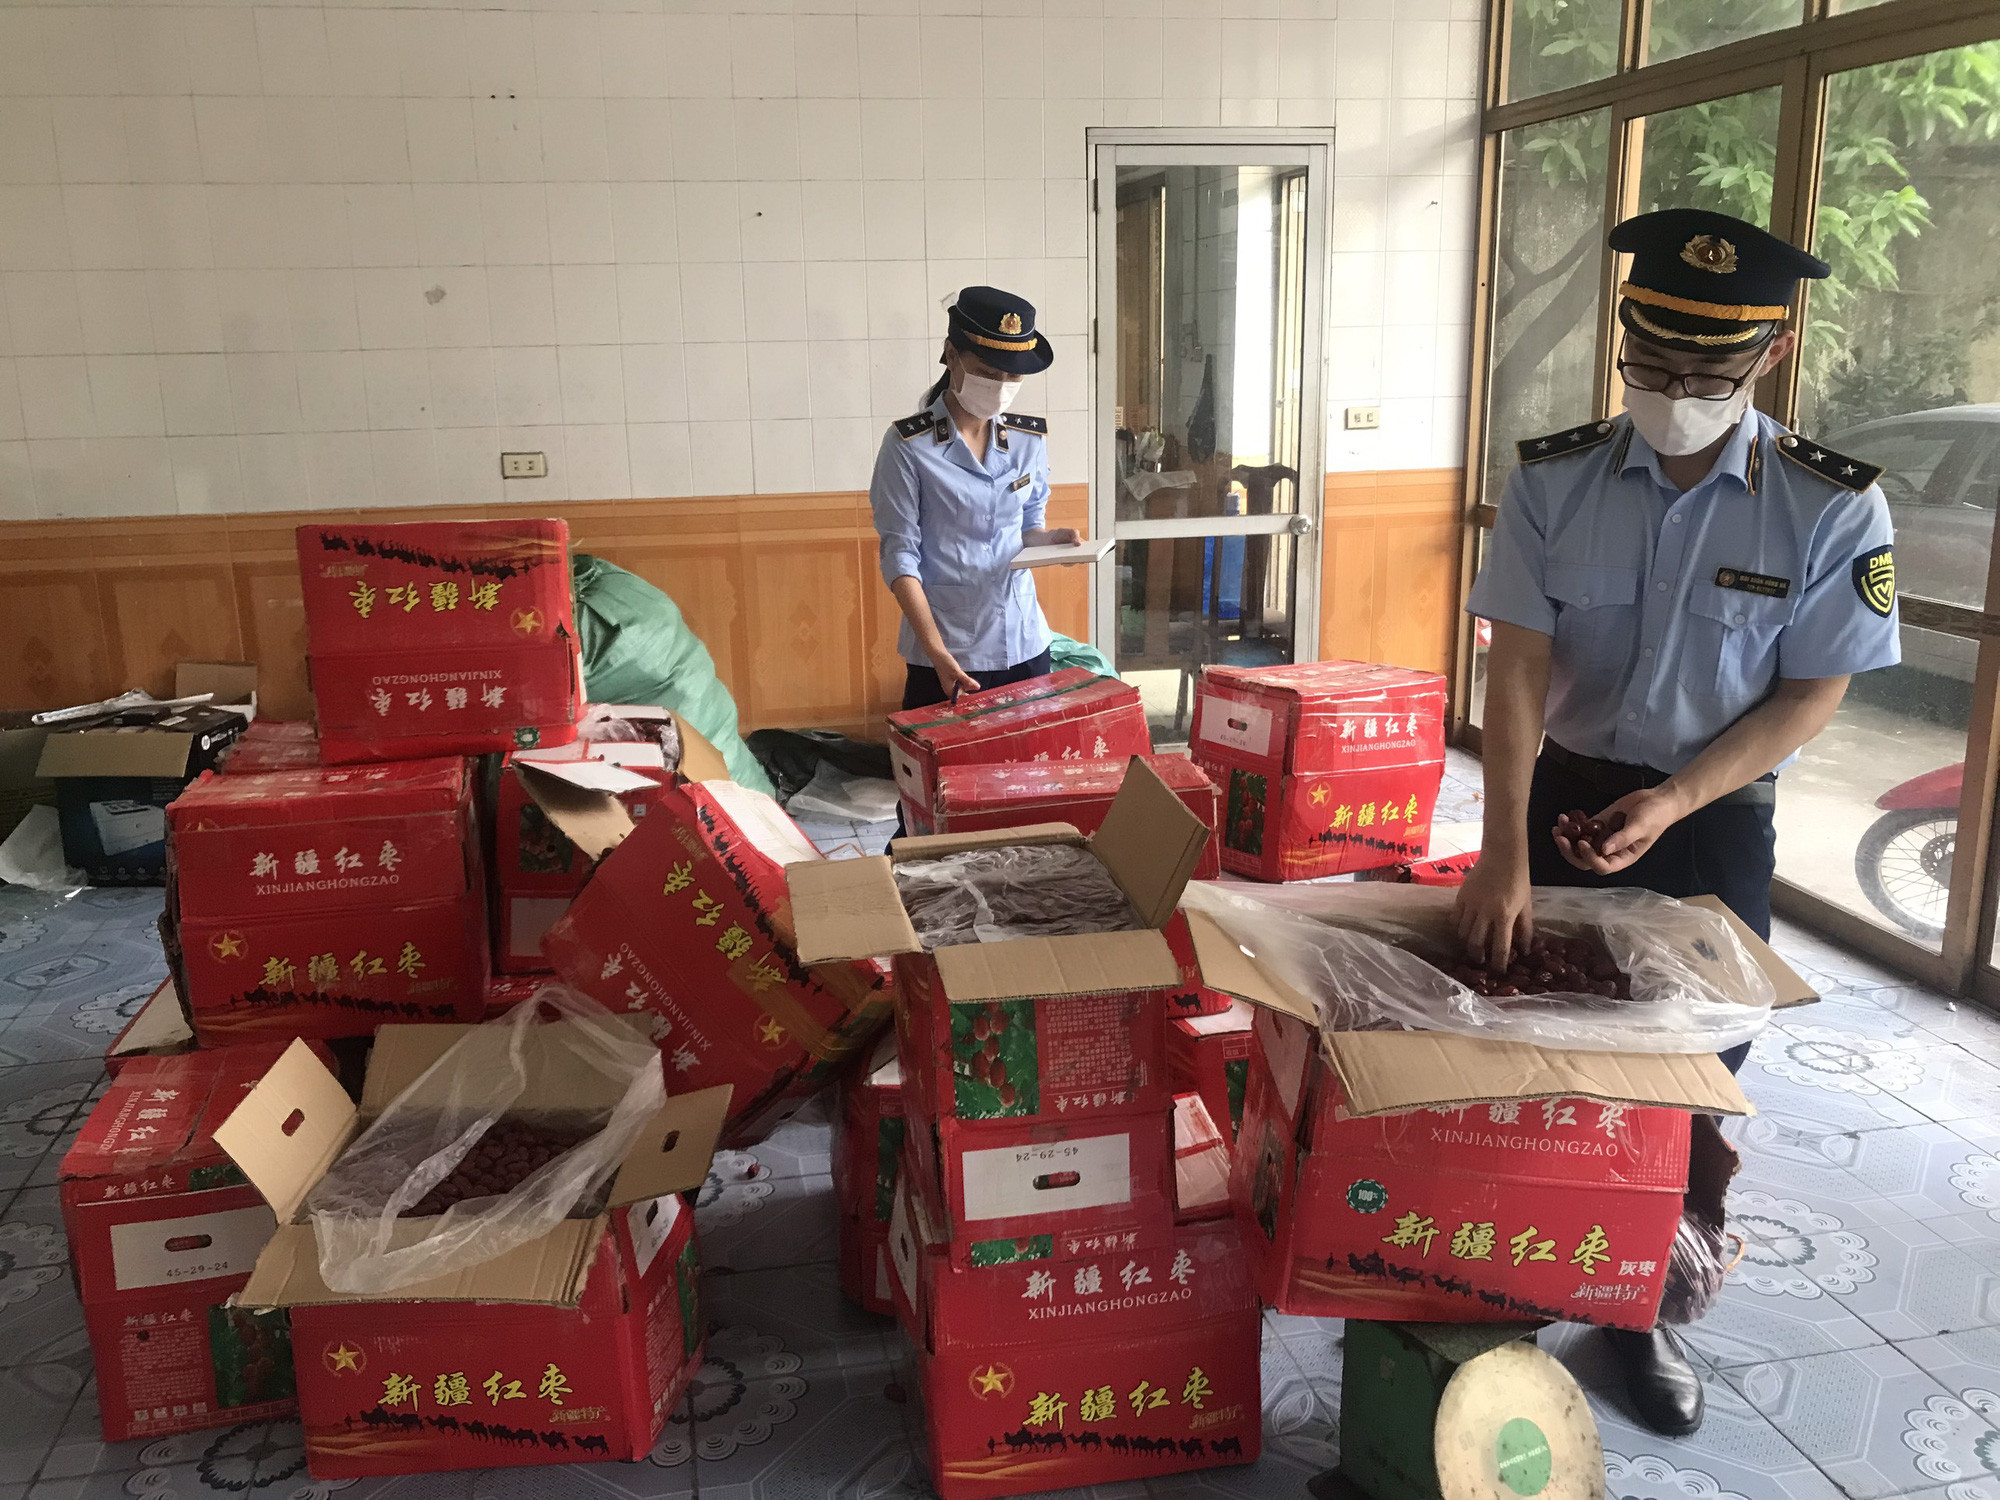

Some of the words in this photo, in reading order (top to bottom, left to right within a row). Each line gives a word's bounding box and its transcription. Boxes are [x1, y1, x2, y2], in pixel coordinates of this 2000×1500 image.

[348, 578, 503, 619] 新疆红枣
[372, 669, 502, 686] XINJIANGHONGZAO
[369, 683, 508, 716] 新疆红枣
[1339, 712, 1418, 740] 新疆红枣
[1341, 739, 1416, 754] XINJIANGHONGZAO
[1329, 793, 1419, 831] 新疆红枣
[249, 840, 402, 881] 新疆红枣
[256, 874, 400, 896] XINJIANGHONGZAO
[663, 860, 787, 991] 新疆红枣
[258, 942, 427, 989] 新疆红枣
[620, 942, 712, 1051] XINJIANGHONGZAO
[1054, 1091, 1128, 1113] 新疆红枣
[1016, 1147, 1079, 1164] 45-29-24
[1430, 1128, 1619, 1157] XINJIANGHONGZAO
[103, 1174, 175, 1199] 新疆红枣
[1066, 1231, 1138, 1255] 新疆红枣
[1381, 1210, 1613, 1276] 新疆红枣
[166, 1261, 229, 1278] 45-29-24
[1021, 1248, 1197, 1303] 新疆红枣
[1618, 1260, 1657, 1277] 灰枣
[123, 1308, 194, 1327] 新疆红枣
[1028, 1287, 1193, 1321] XINJIANGHONGZAO
[376, 1363, 574, 1412] 新疆红枣
[1022, 1366, 1215, 1431] 新疆红枣
